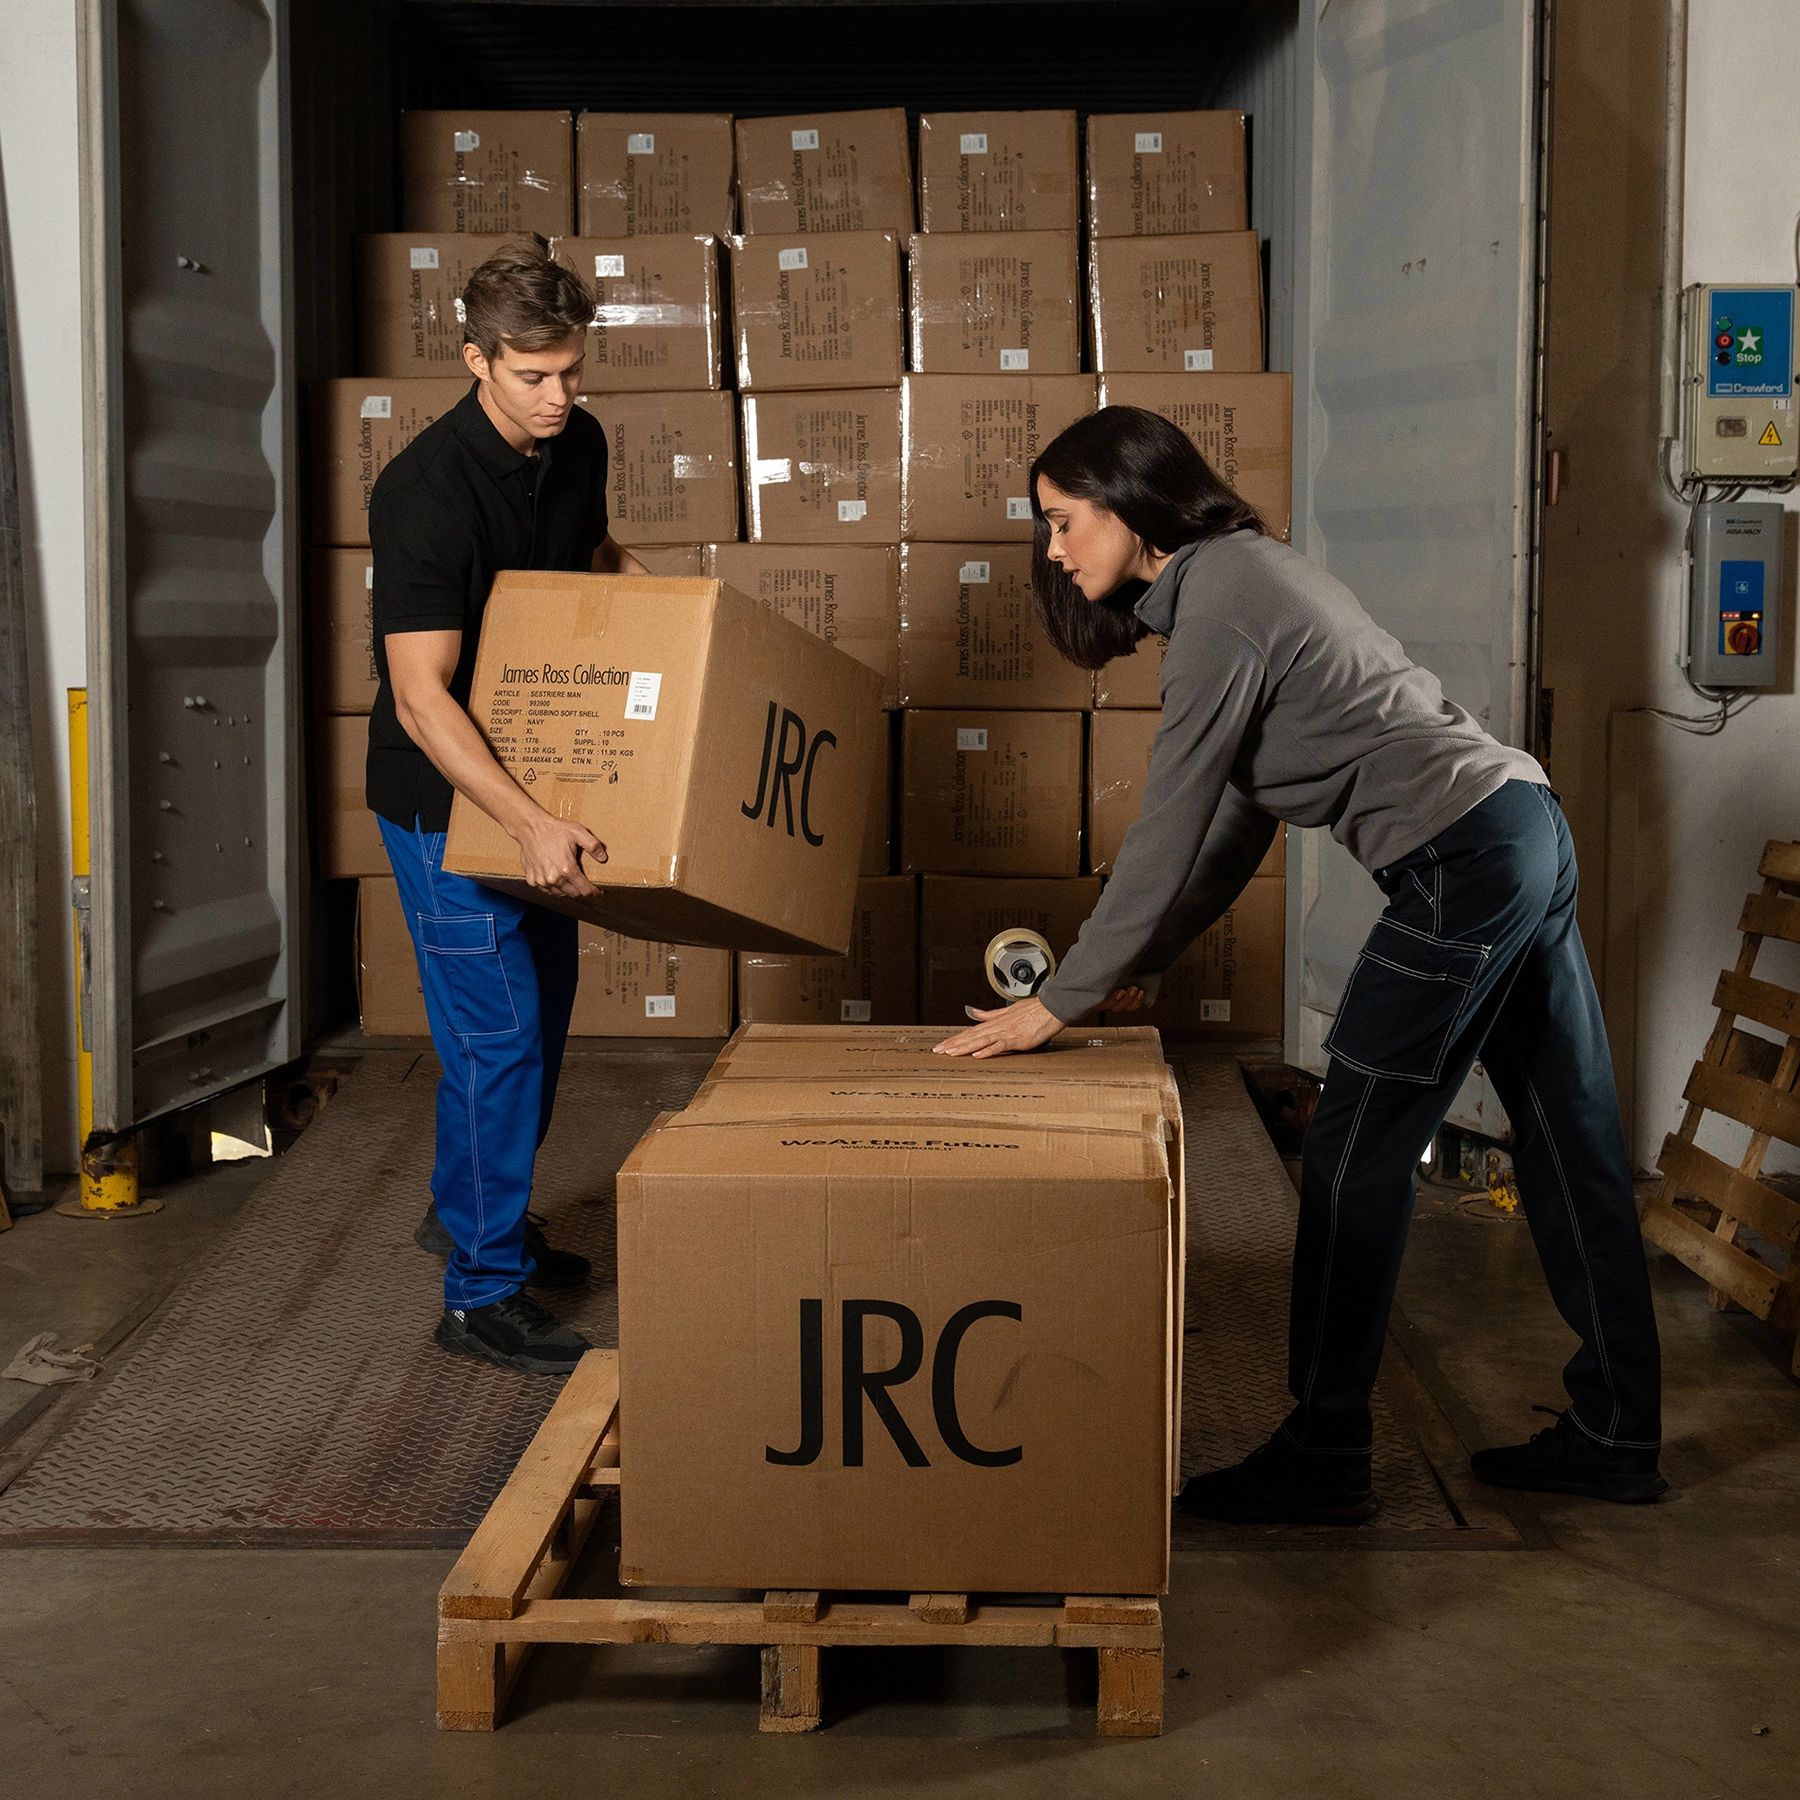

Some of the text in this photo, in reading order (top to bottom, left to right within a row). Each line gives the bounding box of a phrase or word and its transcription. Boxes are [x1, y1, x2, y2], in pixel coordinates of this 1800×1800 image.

[626, 213, 636, 236] ames
[960, 212, 970, 232] ames
[1134, 211, 1143, 235] ames
[409, 270, 422, 309] Collection
[776, 271, 792, 358] James Ross Collection
[1020, 261, 1034, 349] James Ross Collection
[1200, 262, 1216, 350] James Ross Collection
[413, 332, 425, 358] James
[596, 338, 608, 364] James
[1736, 353, 1762, 364] Stop
[1734, 383, 1784, 392] Crawford
[1026, 403, 1040, 432] James
[1224, 406, 1236, 435] James
[358, 418, 372, 459] Collection
[1026, 434, 1040, 454] Ross
[1224, 437, 1238, 458] Ross
[856, 414, 870, 501] James Ross Collection
[359, 461, 373, 481] Ross
[613, 472, 626, 491] Ross
[614, 493, 628, 520] James
[824, 573, 838, 601] James
[824, 604, 838, 624] Ross
[956, 584, 970, 624] Collection
[956, 627, 969, 646] Ross
[500, 663, 629, 686] James Ross Collection
[956, 649, 970, 677] James
[741, 700, 836, 847] JRC
[951, 751, 966, 791] Collection
[950, 793, 965, 812] Ross
[1223, 937, 1237, 958] Ross
[666, 956, 680, 996] Collection
[1222, 960, 1237, 1000] Collection
[926, 1140, 1020, 1149] Future
[766, 1298, 1022, 1468] JRC
